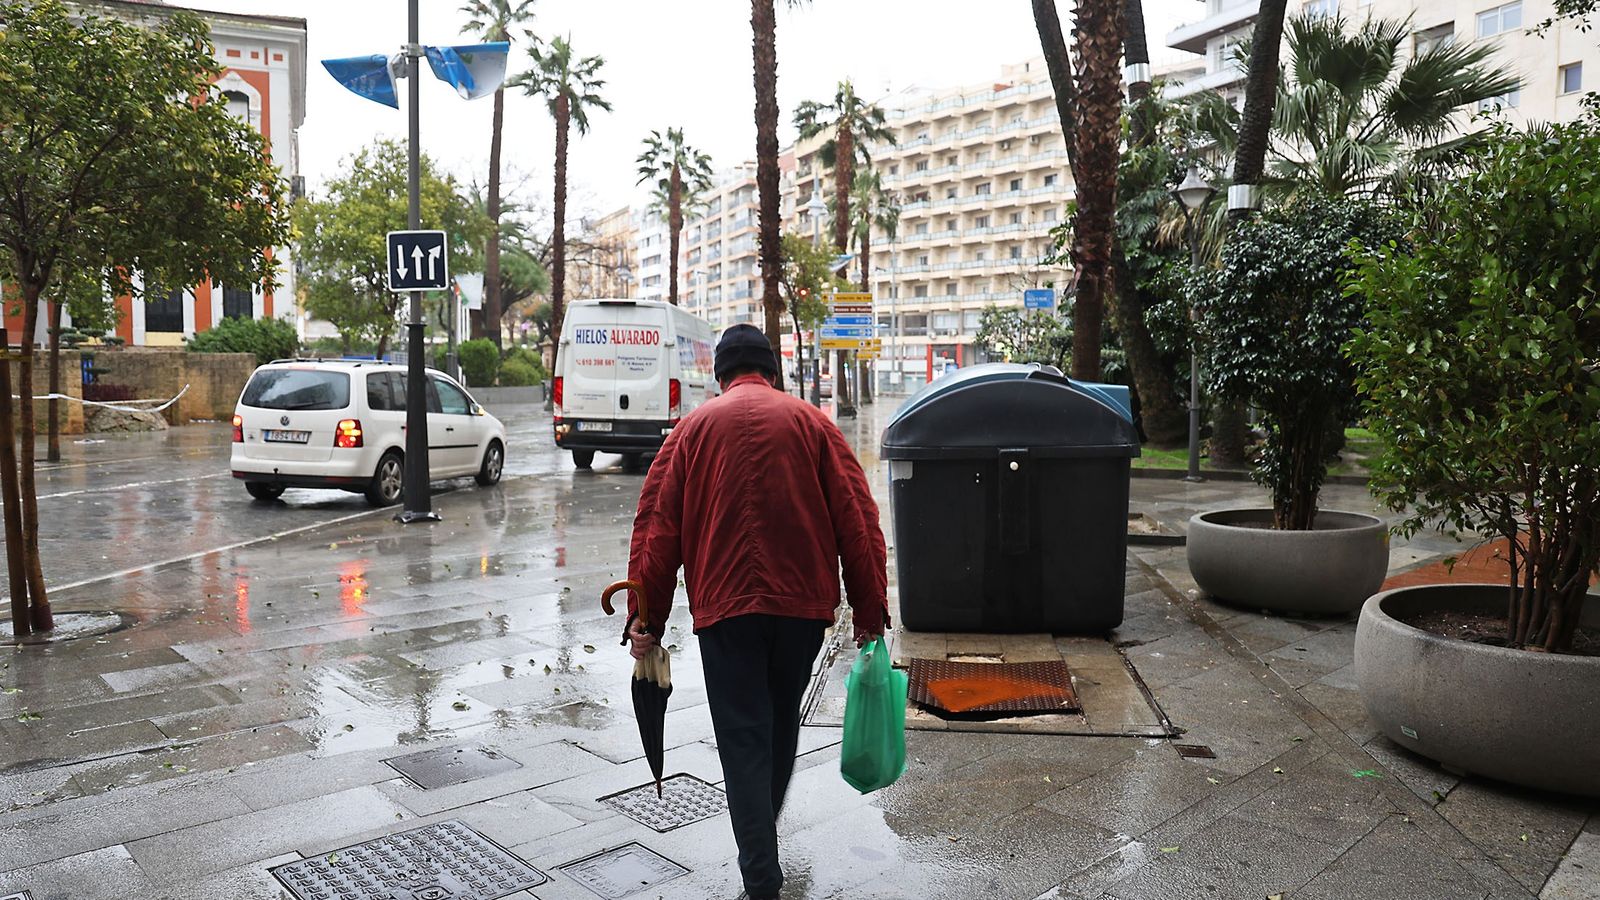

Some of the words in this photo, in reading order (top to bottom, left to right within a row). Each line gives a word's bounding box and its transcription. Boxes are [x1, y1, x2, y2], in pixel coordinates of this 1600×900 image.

[576, 329, 607, 344] HIELOS
[610, 329, 660, 346] ALVARADO
[291, 432, 306, 441] LKT
